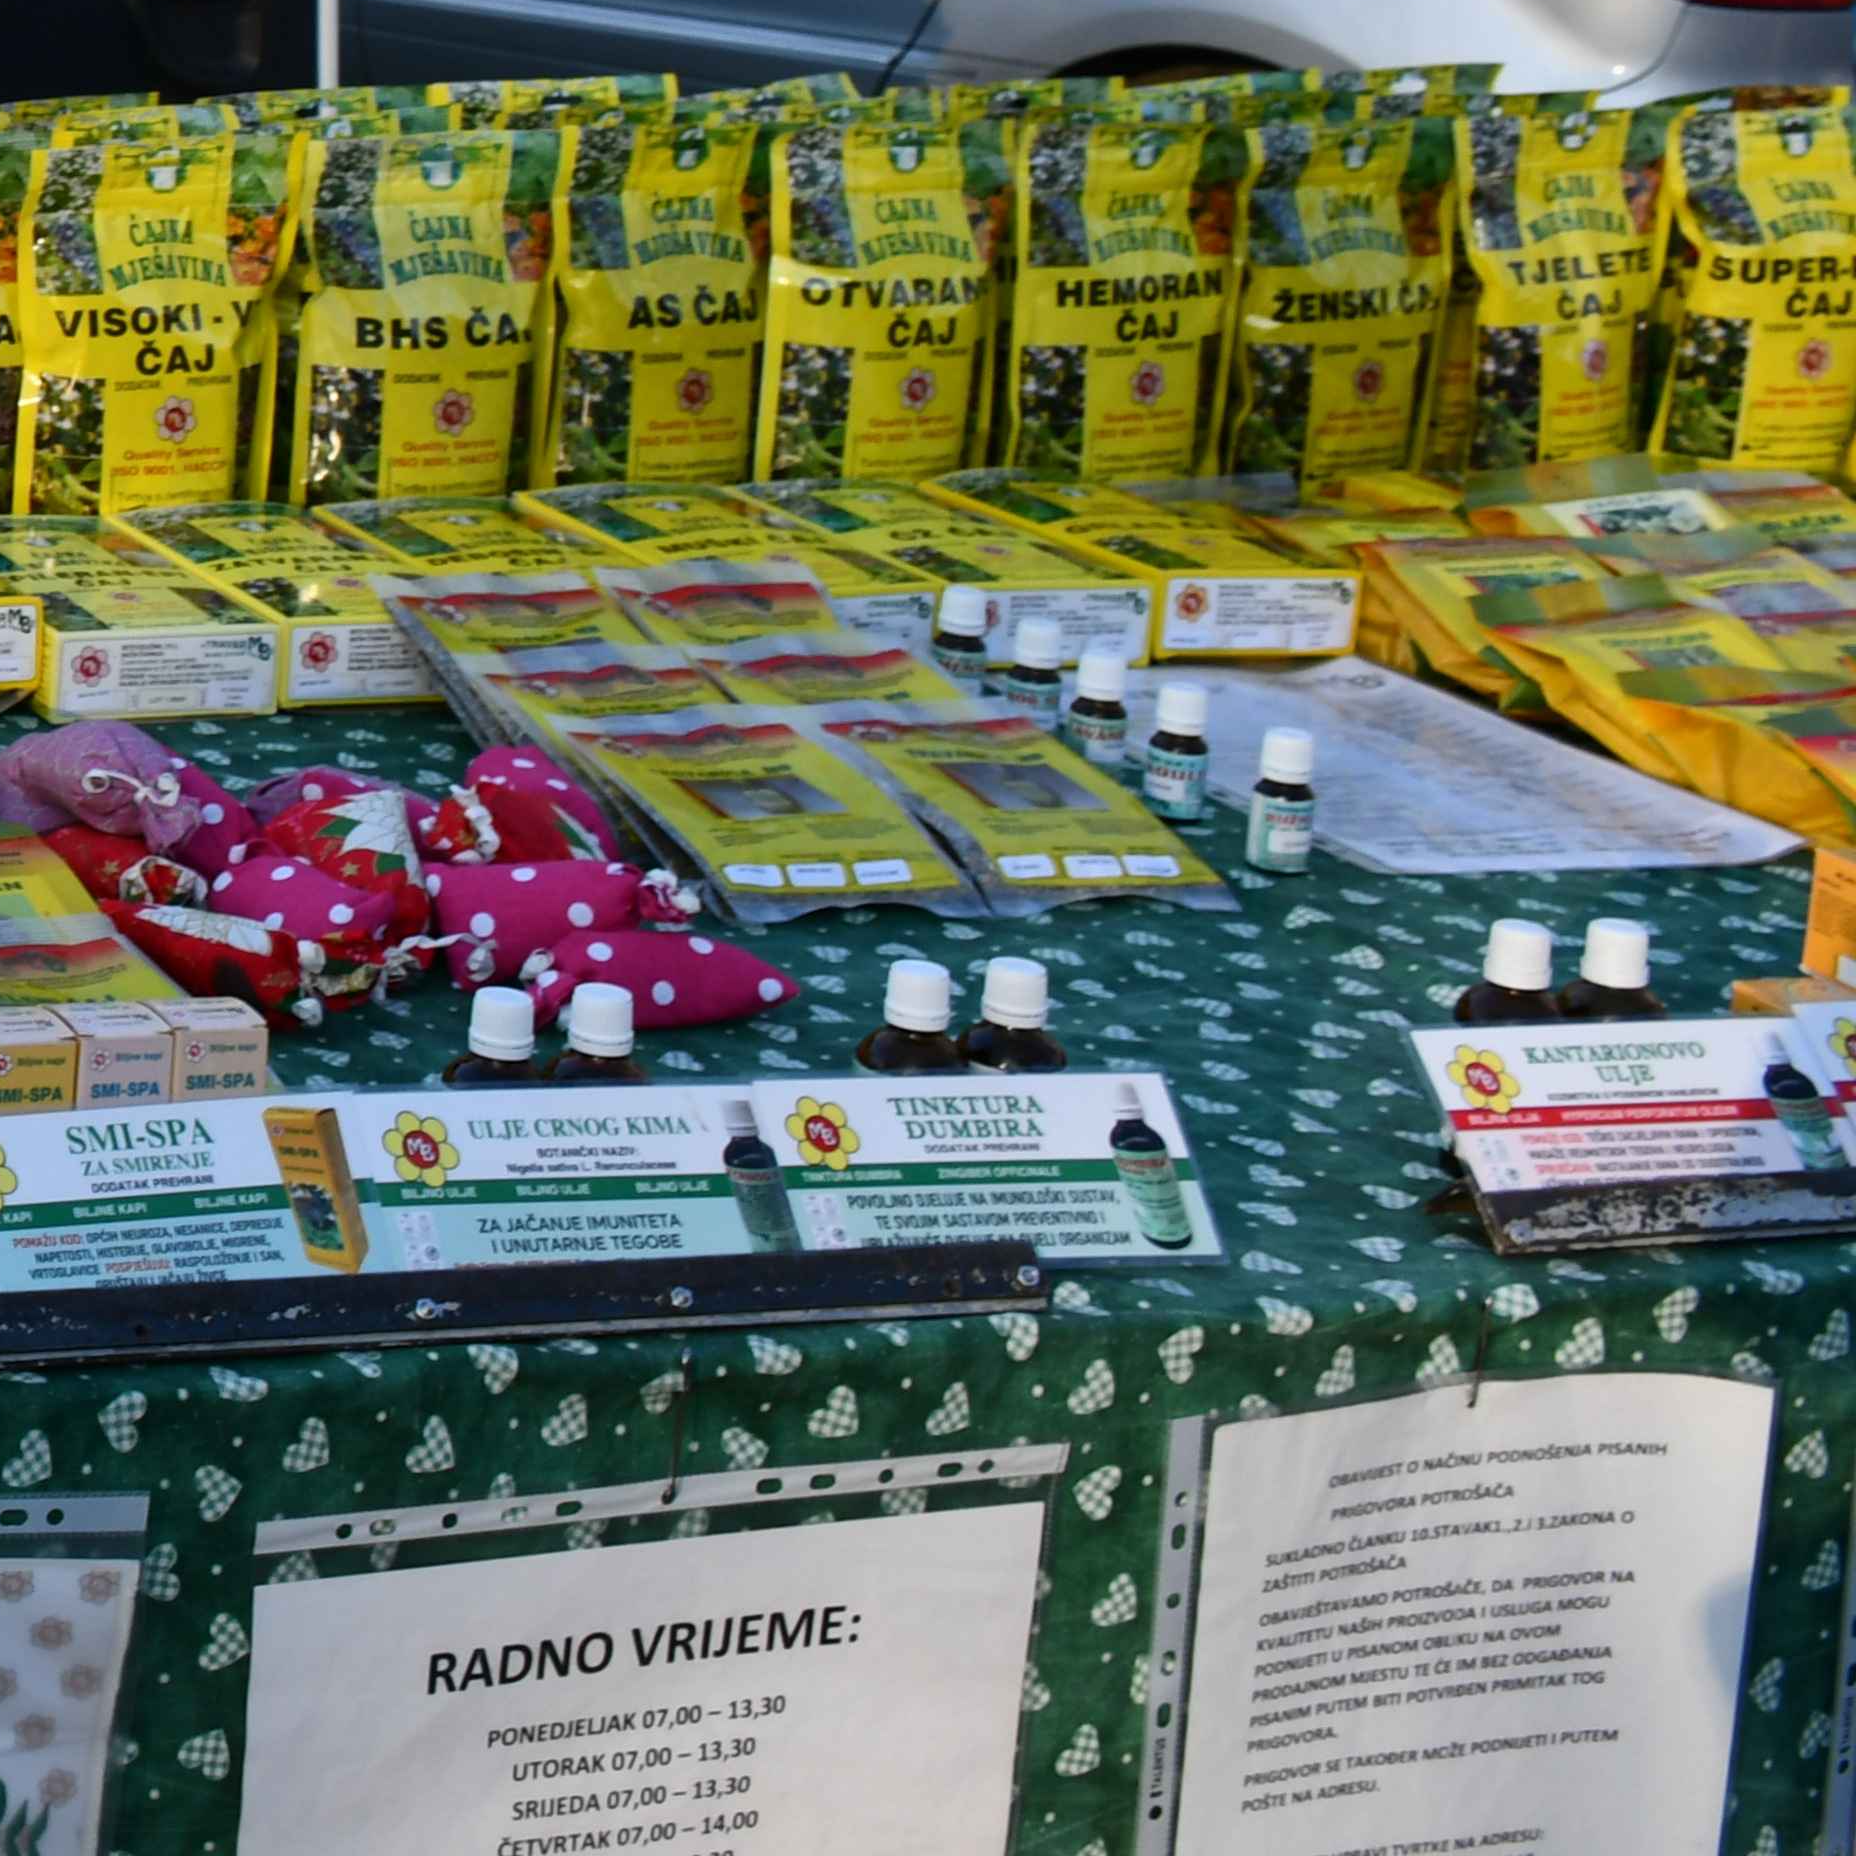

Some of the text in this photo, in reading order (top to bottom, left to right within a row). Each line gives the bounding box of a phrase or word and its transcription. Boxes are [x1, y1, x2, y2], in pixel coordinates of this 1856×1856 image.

[629, 284, 758, 328] AS ČAJ
[1057, 270, 1224, 308] HEMORAN
[1274, 284, 1388, 322] ŽENSKI
[56, 302, 202, 337] VISOKI
[356, 315, 448, 351] BHS
[1116, 304, 1178, 343] ČAJ
[136, 340, 214, 377] ČAJ
[1524, 1042, 1704, 1064] KANTARIONOVO
[90, 1080, 161, 1099] SMI-SPA
[1595, 1063, 1655, 1085] ULJE
[887, 1095, 1042, 1116] TINKTURA
[66, 1119, 214, 1153] SMI-SPA
[468, 1115, 690, 1140] ULJE CRNOG KIMA
[80, 1152, 214, 1175] ZA SMIRENJE
[479, 1212, 682, 1233] ZA JAČANJE IMUNITETA
[501, 1234, 682, 1253] UNUTARNJE TEGOBE
[1329, 1463, 1403, 1489] OBAVIJEST
[1423, 1453, 1482, 1471] NAČINU
[1487, 1443, 1591, 1464] PODNOŠENJA
[1597, 1442, 1668, 1456] PISANIH
[1332, 1483, 1514, 1520] PRIGOVORA POTROŠAČA
[1263, 1556, 1407, 1593] ZAŠTITI POTROŠAČA
[426, 1606, 862, 1695] RADNO VRIJEME:
[487, 1694, 786, 1748] PONEDJELJAK 07,00 13,30
[512, 1735, 757, 1781] UTORAK 07,00 13,30
[512, 1774, 751, 1820] SRIJEDA 07,00 13,30
[496, 1810, 759, 1856] ČETVRTAK 07,00 14,00
